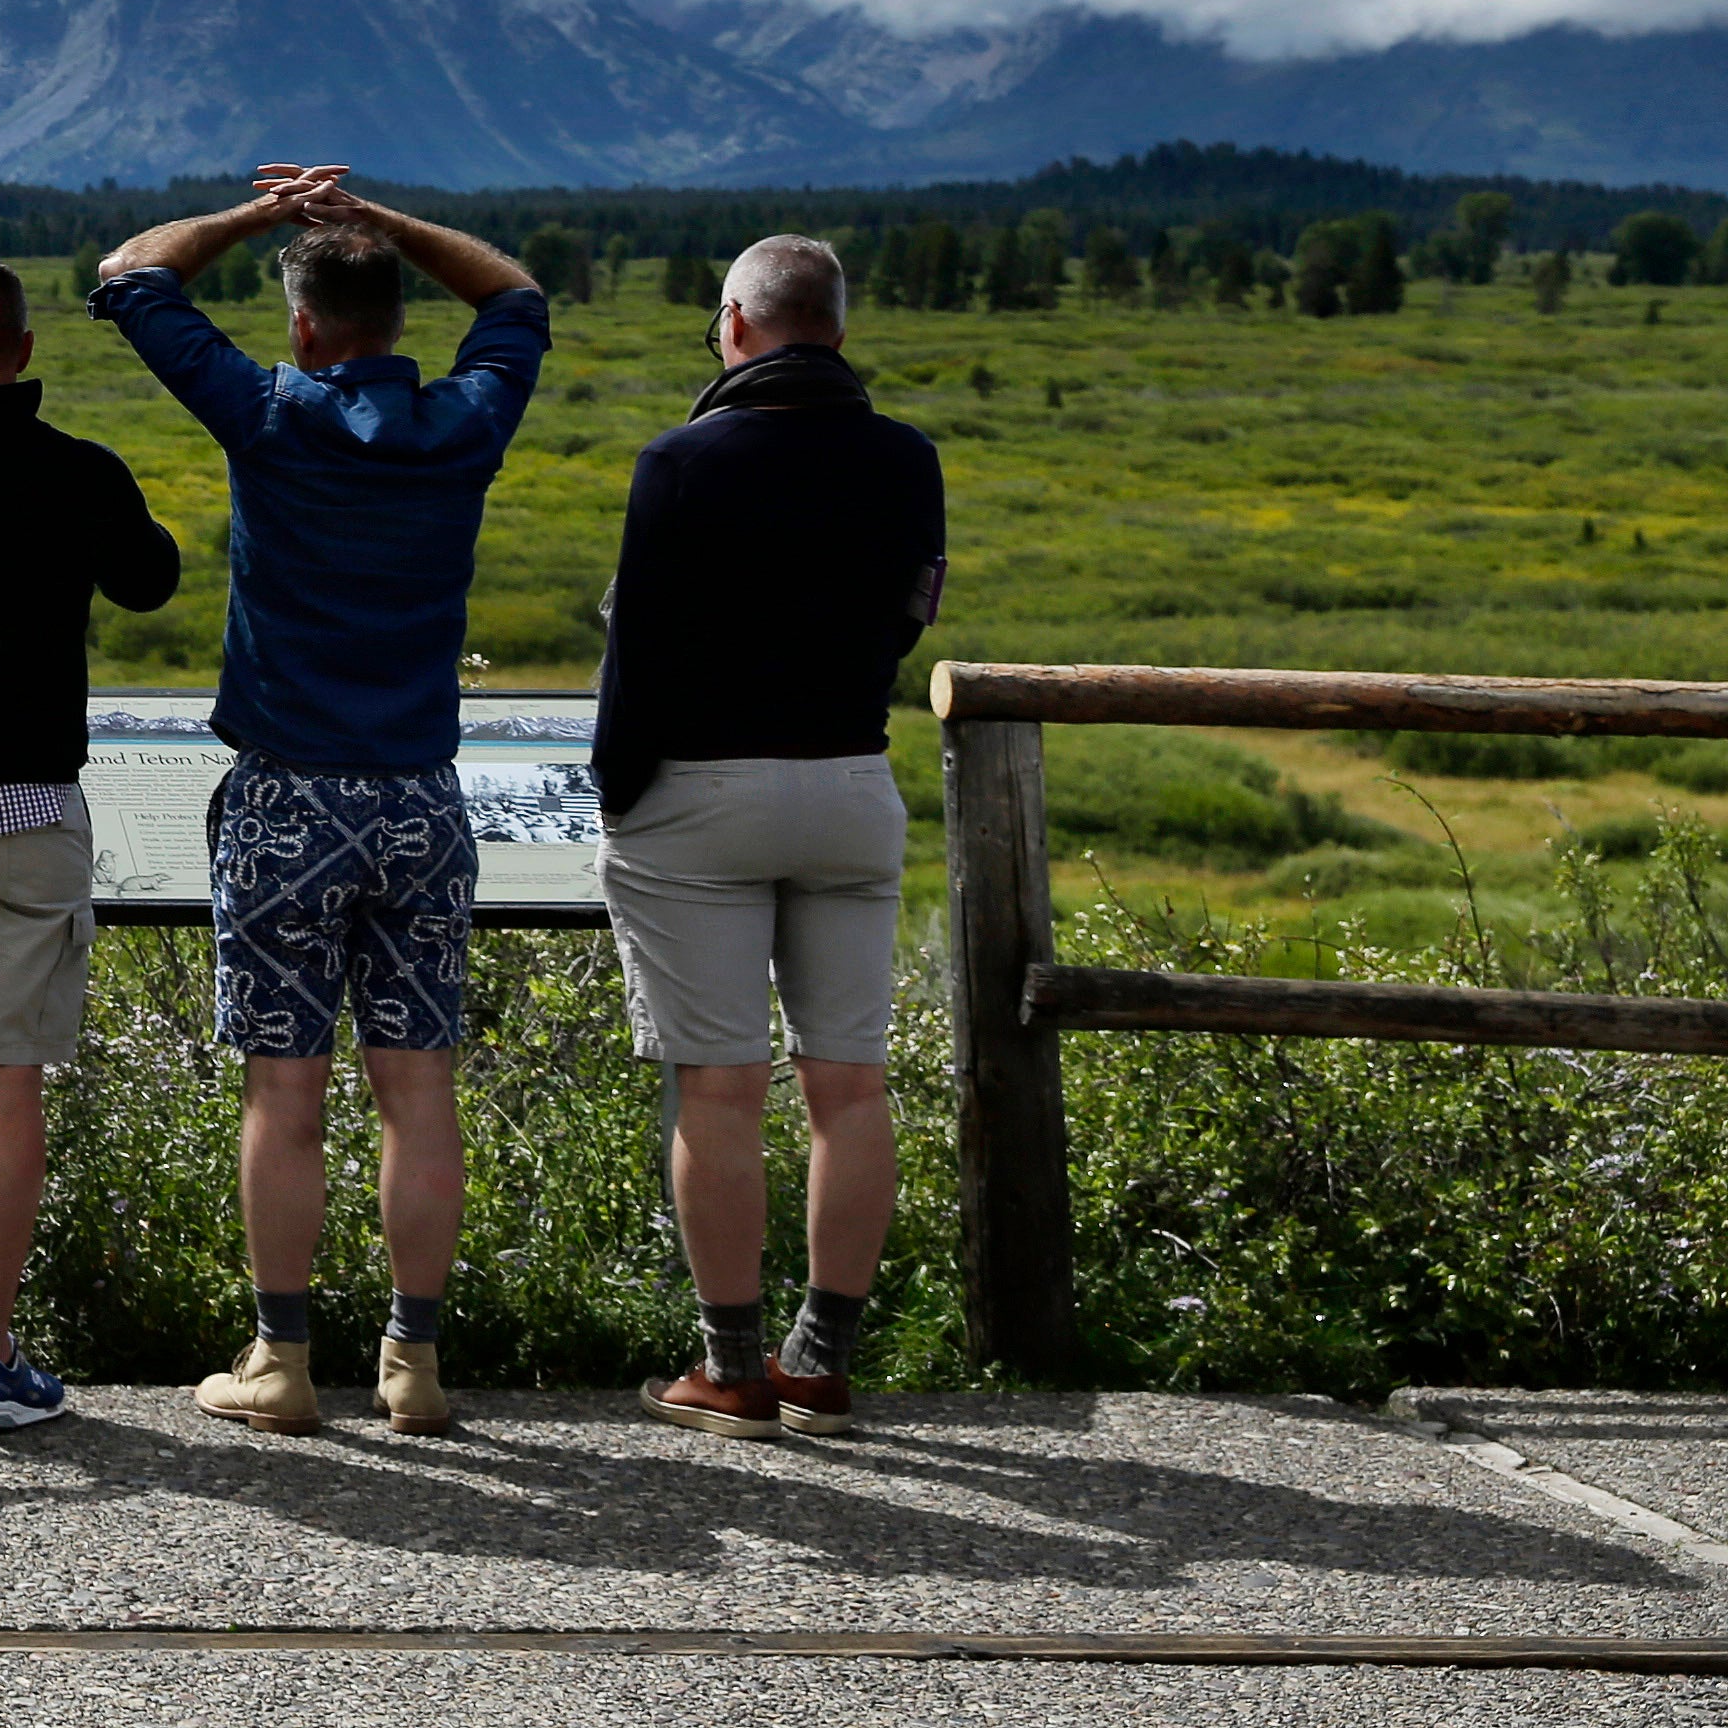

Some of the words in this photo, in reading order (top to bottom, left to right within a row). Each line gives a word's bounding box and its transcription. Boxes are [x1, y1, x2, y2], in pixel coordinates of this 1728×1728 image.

[87, 751, 128, 765] and
[131, 752, 193, 766] Teton
[200, 752, 237, 767] Nat
[134, 812, 160, 822] Help
[162, 812, 198, 821] Protect
